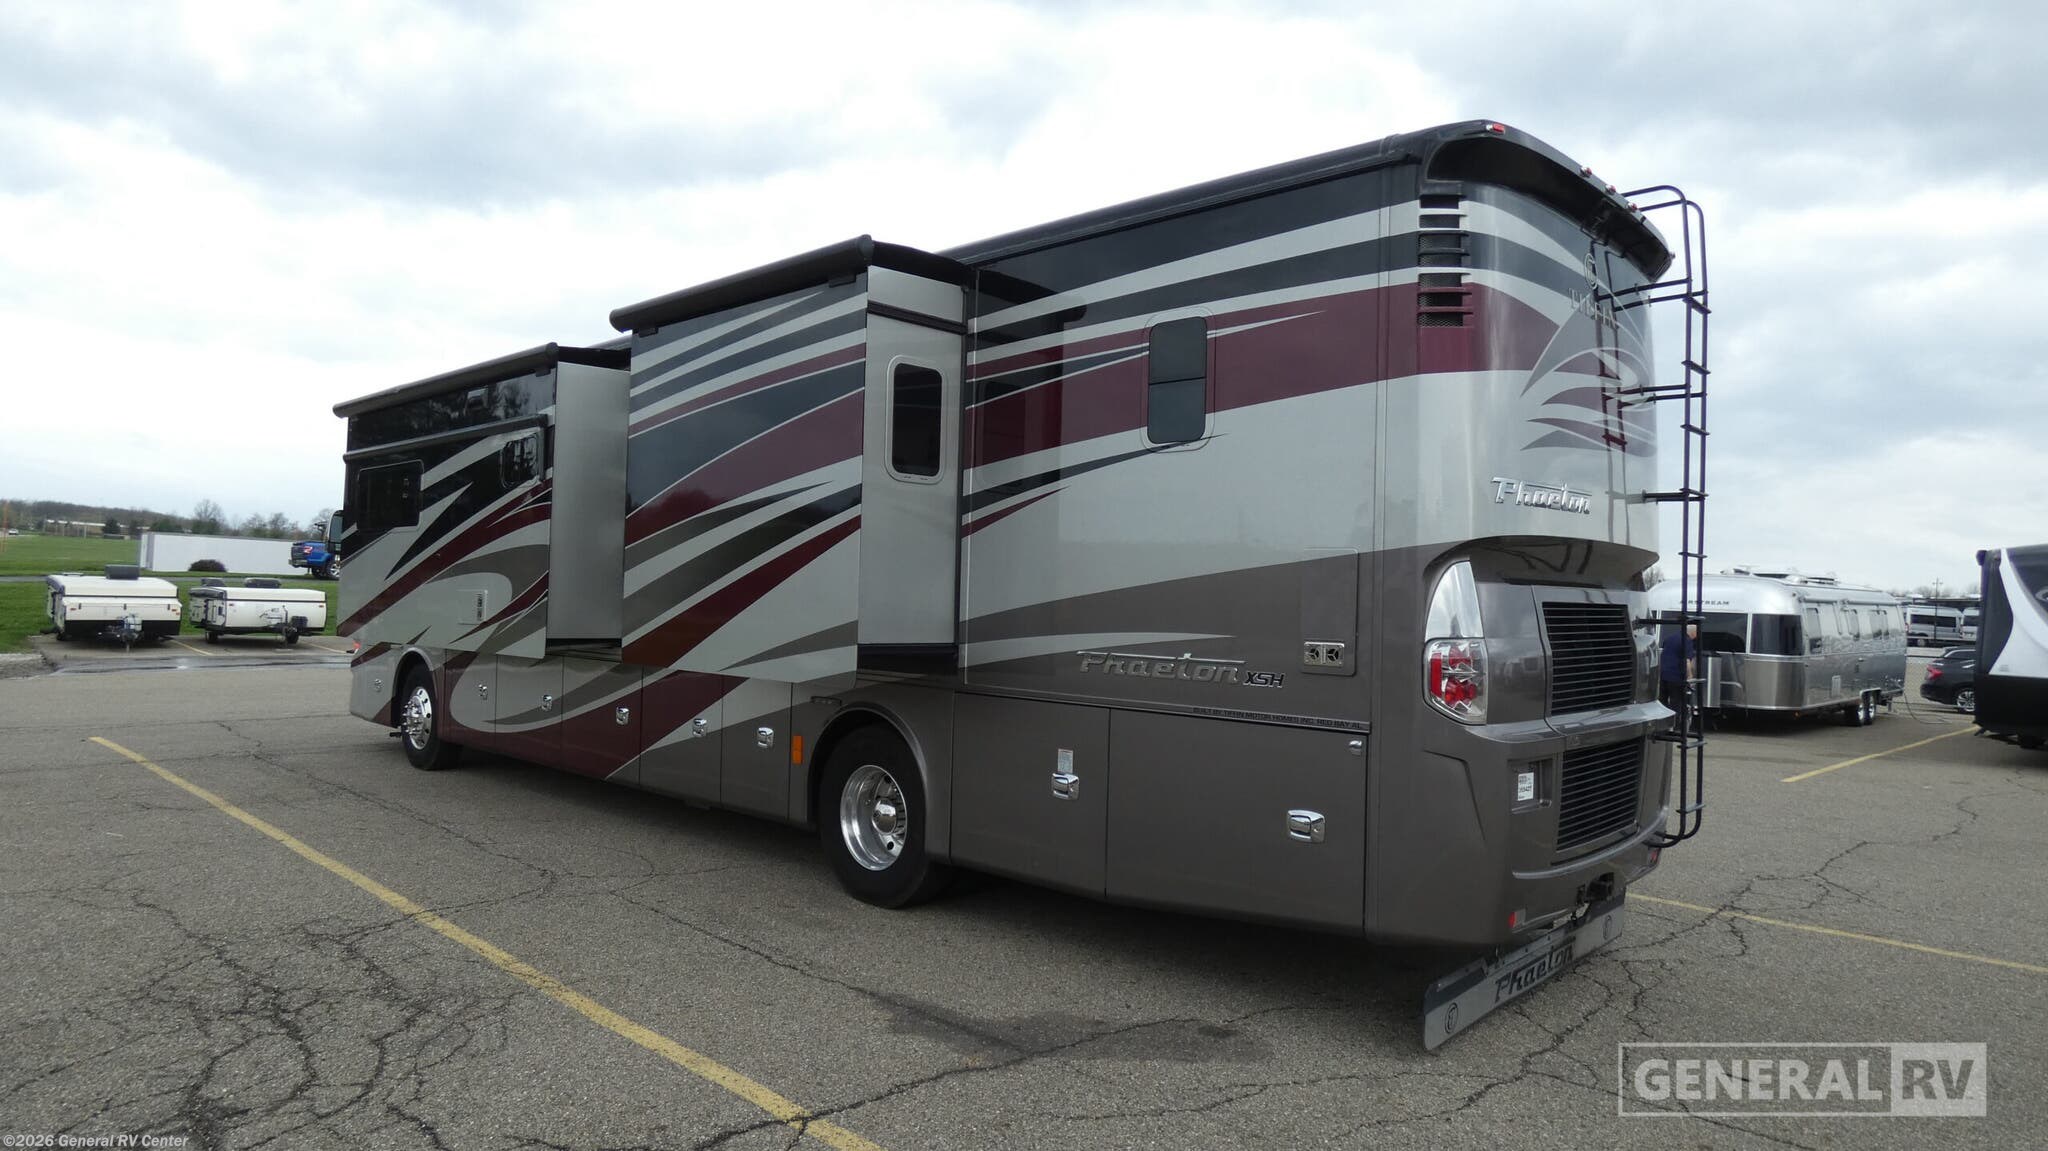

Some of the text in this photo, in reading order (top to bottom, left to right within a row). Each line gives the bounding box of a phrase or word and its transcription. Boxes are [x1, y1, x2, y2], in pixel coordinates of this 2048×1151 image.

[1491, 476, 1593, 515] Phaeton
[1077, 651, 1285, 689] Phaeton XSH
[1495, 936, 1577, 1003] Phaeton
